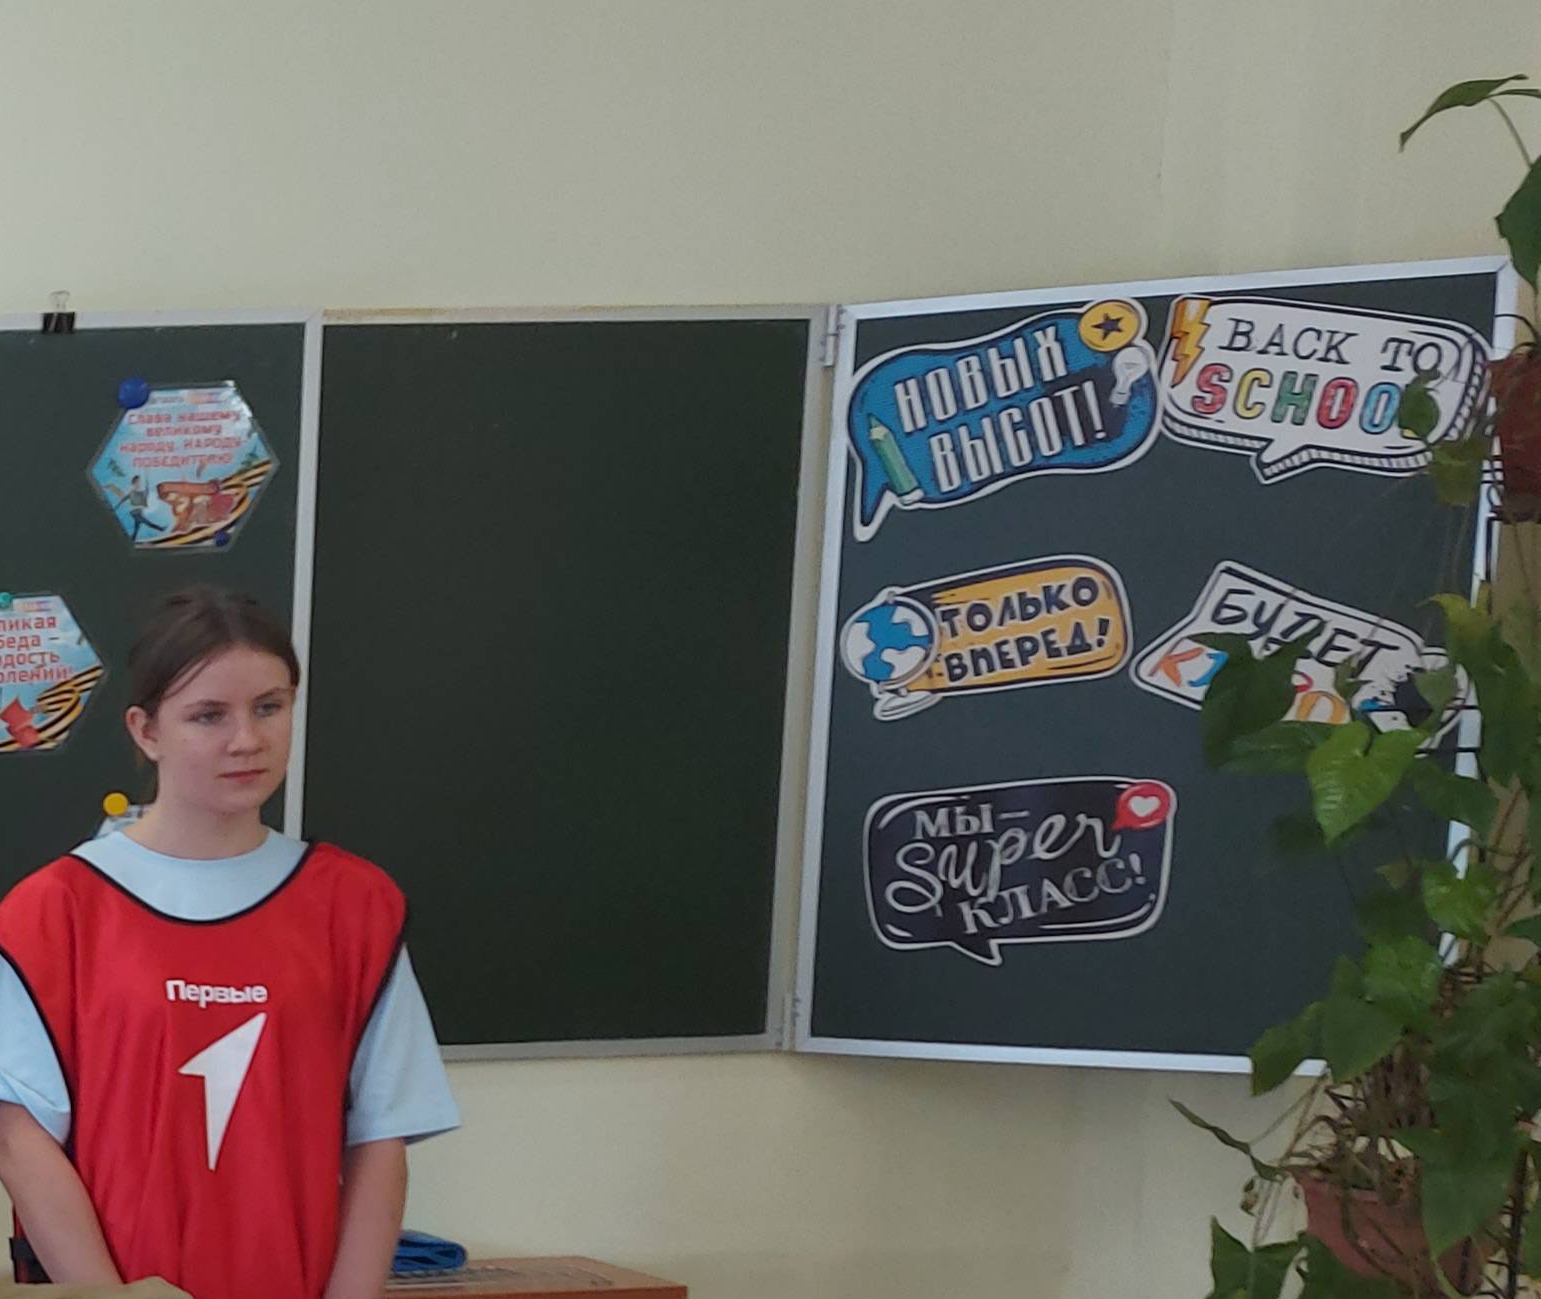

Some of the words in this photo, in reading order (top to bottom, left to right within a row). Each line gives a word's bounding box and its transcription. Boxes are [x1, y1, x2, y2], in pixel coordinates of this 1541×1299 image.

[893, 325, 1070, 434] НОВЫХ
[1217, 317, 1359, 365] BACK
[1379, 336, 1442, 373] TO
[927, 379, 1109, 495] ВЫСОТ!
[1191, 363, 1417, 440] SCHOO
[938, 574, 1100, 640] ТОЛЬКО
[945, 615, 1112, 684] ВПЕРЕД!
[884, 811, 1123, 918] Super
[956, 853, 1148, 936] КЛАСС!
[165, 978, 268, 1007] Первые
